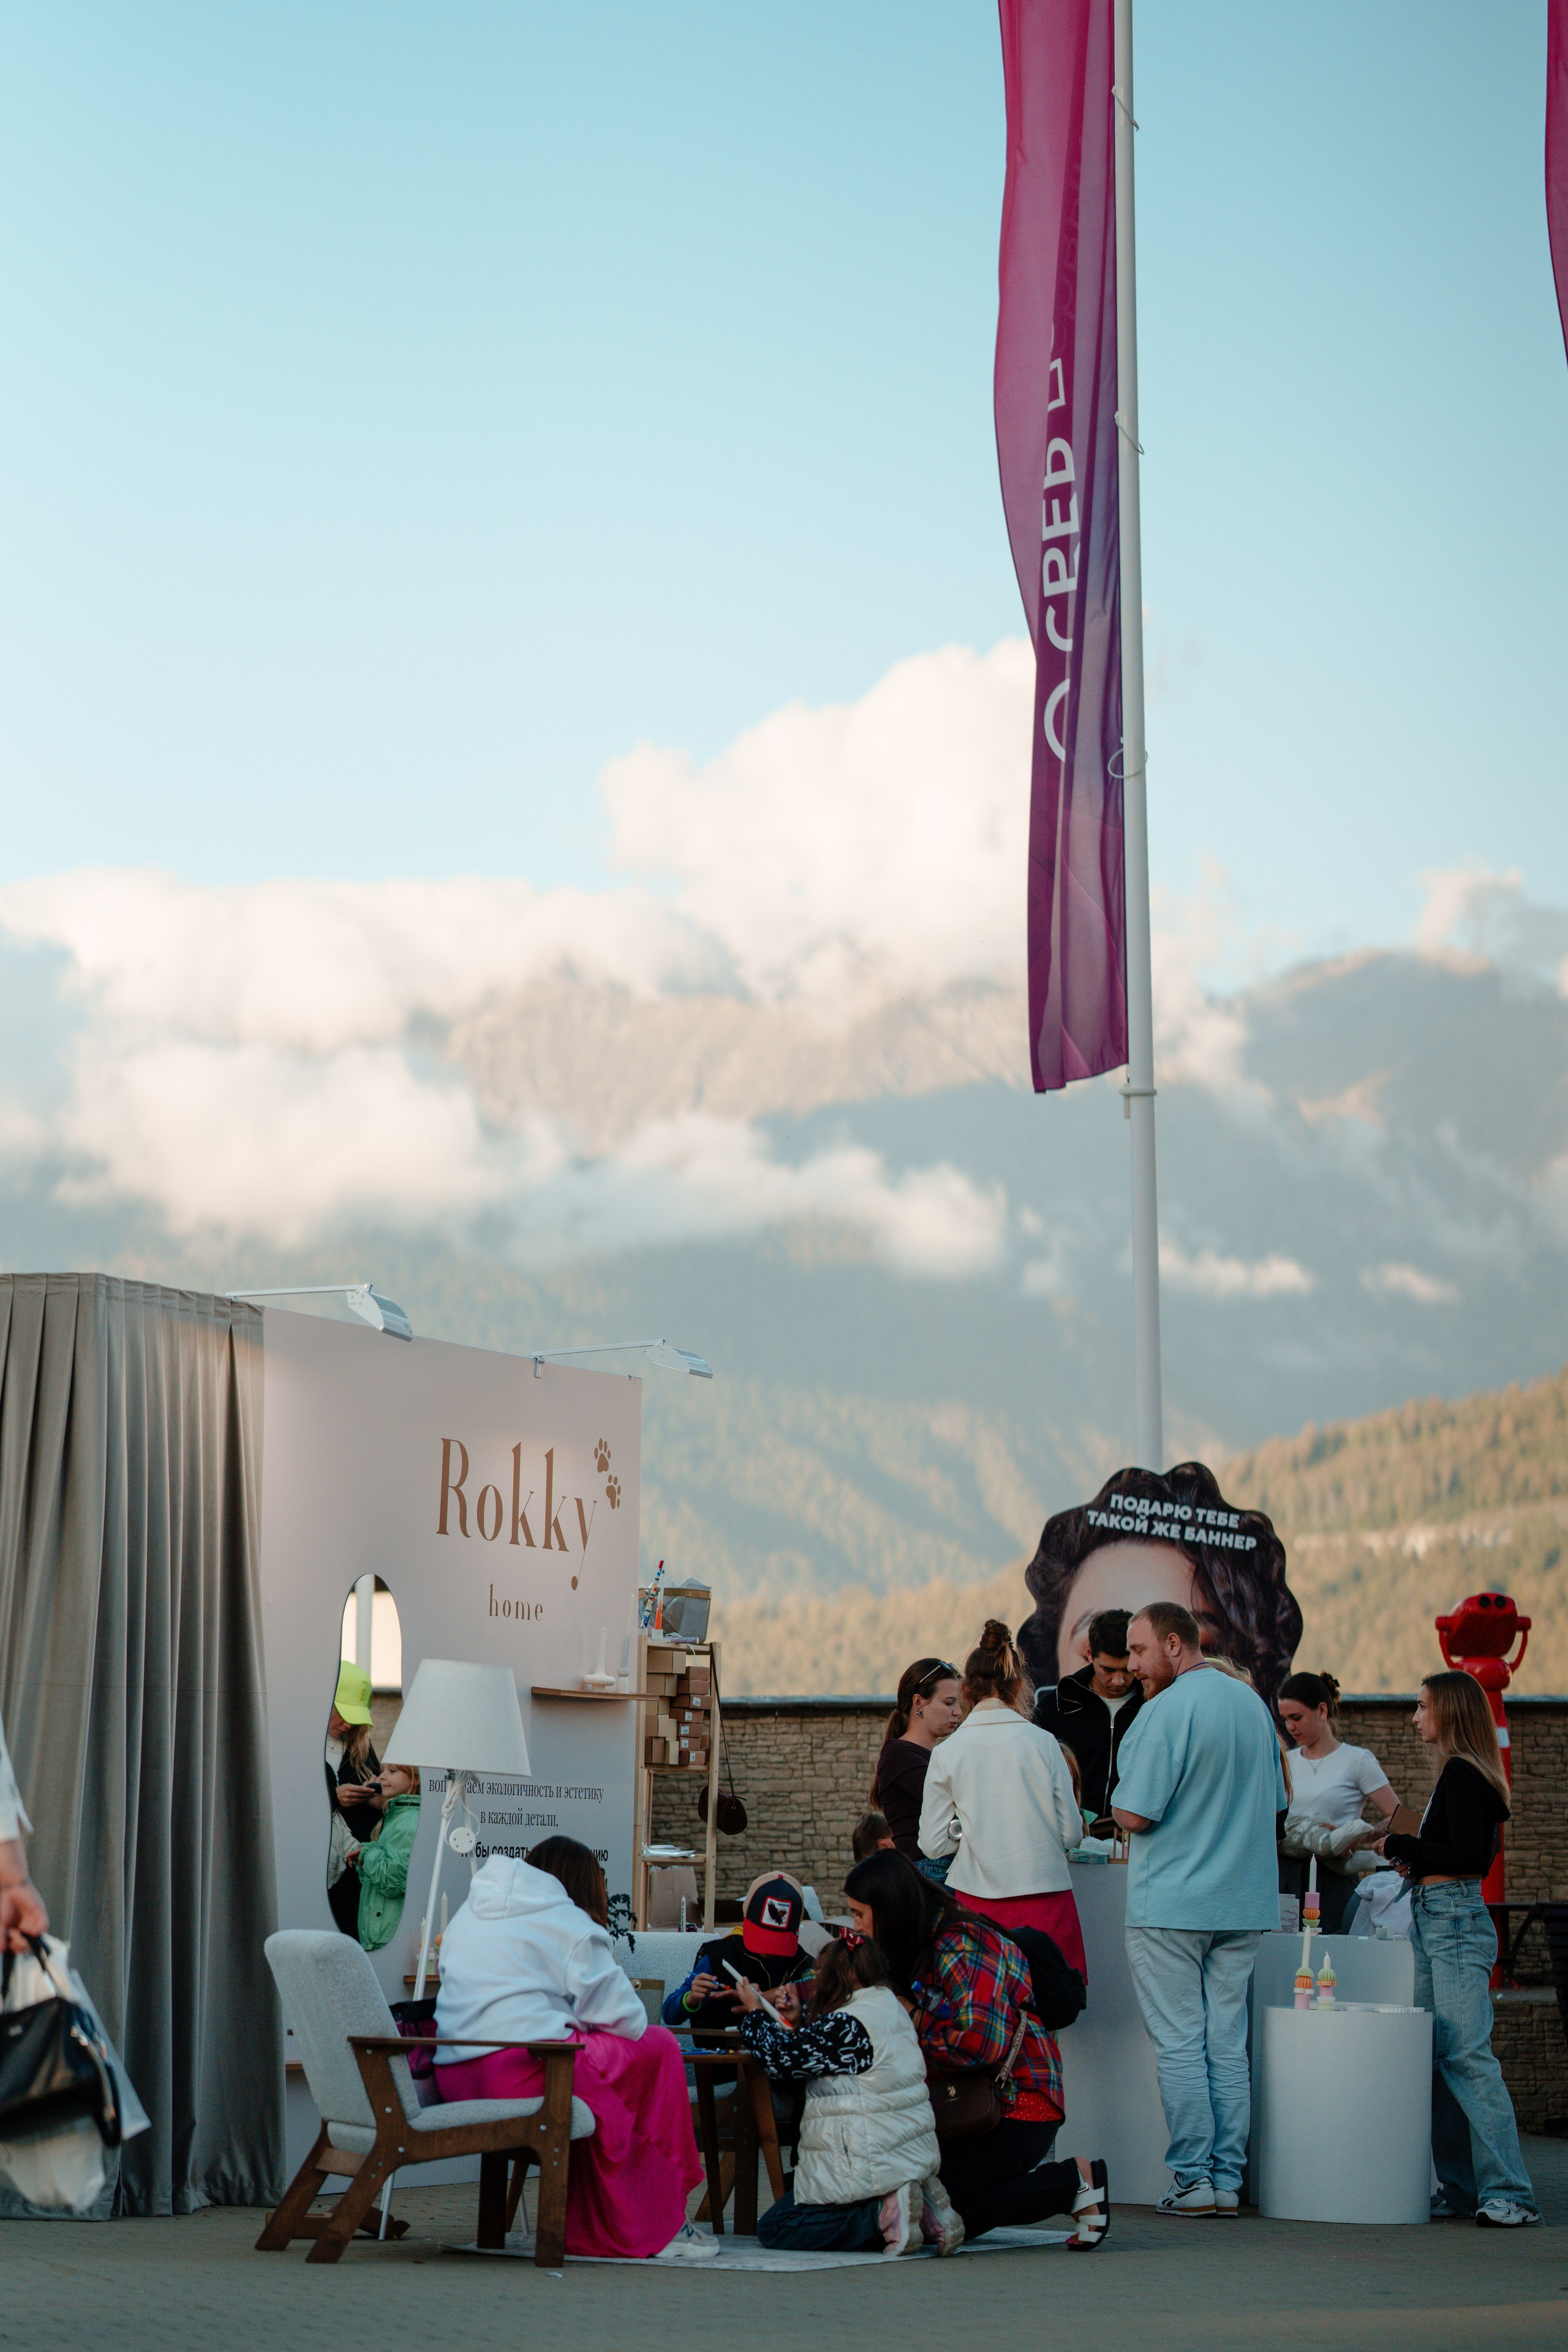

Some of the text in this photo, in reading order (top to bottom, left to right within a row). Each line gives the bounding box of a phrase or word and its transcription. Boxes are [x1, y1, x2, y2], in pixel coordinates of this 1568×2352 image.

[435, 1437, 598, 1591] Rokky
[1110, 1493, 1240, 1529] ПОДАРЮ ТЕБЕ
[1087, 1509, 1257, 1551] ТАКОЙ ЖЕ БАННЕР
[489, 1583, 543, 1621] home
[429, 1779, 604, 1804] вопаем экологичность и эстетику
[480, 1807, 558, 1829] в каждой детали,
